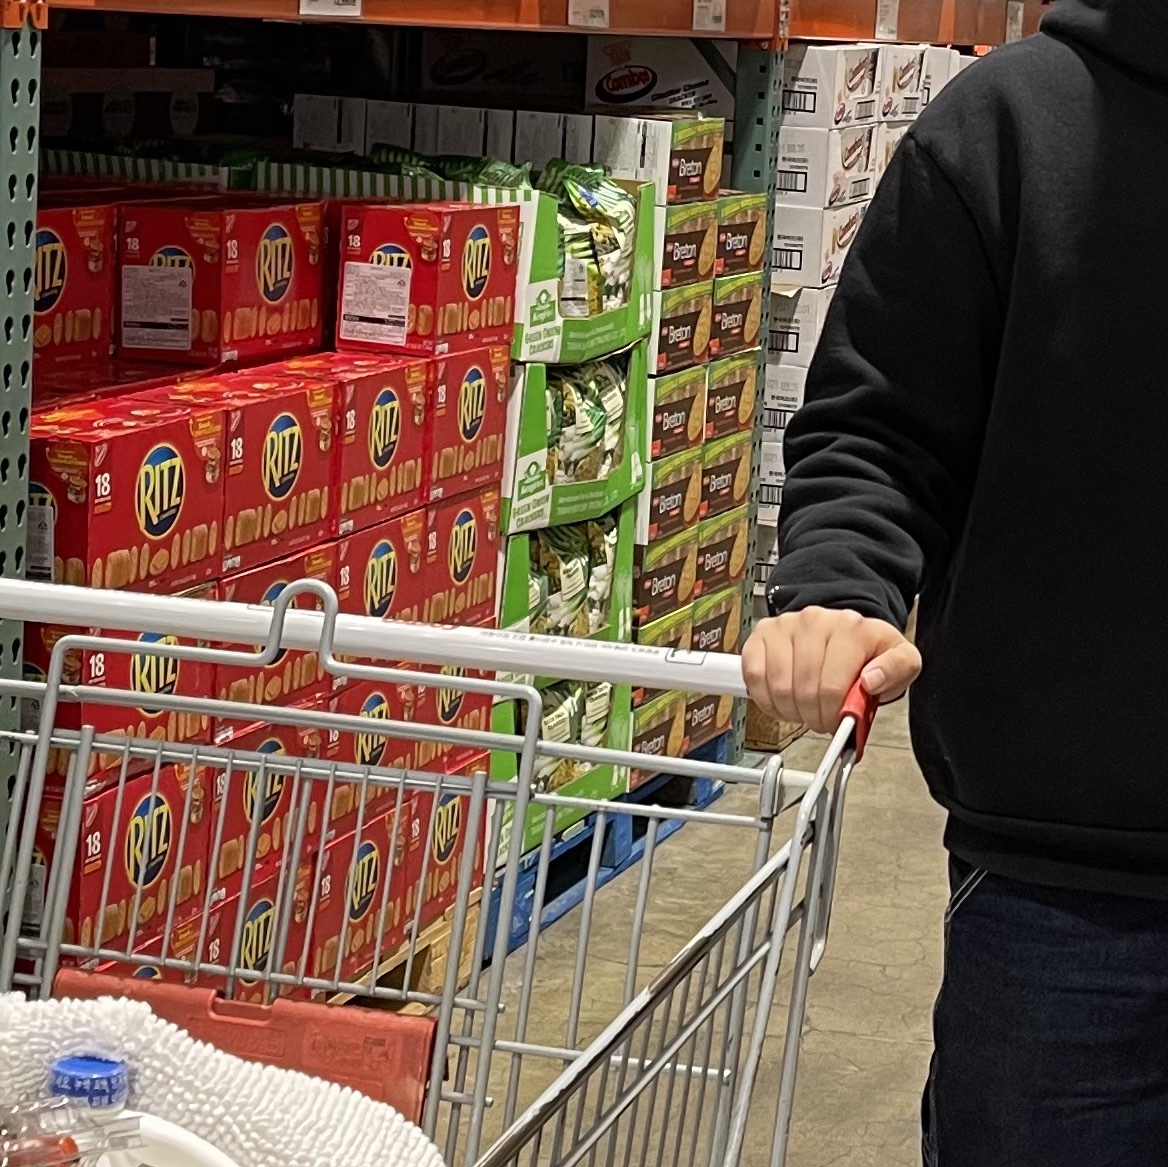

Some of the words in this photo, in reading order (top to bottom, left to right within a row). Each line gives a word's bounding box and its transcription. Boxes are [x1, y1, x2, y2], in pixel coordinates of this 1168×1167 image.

[679, 158, 703, 177] Breton
[126, 237, 140, 251] 18
[226, 239, 239, 259] 18
[348, 234, 361, 248] 18
[442, 239, 451, 258] 18
[674, 243, 697, 260] Breton
[726, 232, 748, 250] Breton
[260, 237, 293, 292] RITZ
[463, 237, 491, 289] RITZ
[721, 312, 743, 330] Breton
[668, 325, 691, 344] Breton
[437, 383, 446, 403] 18
[459, 378, 485, 428] RITZ
[715, 395, 737, 413] Breton
[346, 409, 356, 430] 18
[370, 401, 399, 457] RITZ
[662, 411, 686, 431] Breton
[231, 437, 243, 460] 18
[264, 425, 301, 494] RITZ
[95, 472, 111, 497] 18
[710, 473, 732, 492] Breton
[139, 457, 182, 531] RITZ
[659, 492, 682, 513] Breton
[427, 531, 437, 550] 18
[450, 518, 476, 572] RITZ
[704, 551, 728, 571] Breton
[340, 565, 350, 586] 18
[365, 550, 396, 612] RITZ
[651, 573, 676, 597] Breton
[699, 626, 722, 647] Breton
[89, 653, 105, 678] 18
[691, 703, 715, 726] Breton
[411, 818, 421, 838] 18
[435, 795, 460, 853] RITZ
[85, 831, 101, 857] 18
[128, 804, 169, 882] RTZ
[321, 875, 332, 895] 18
[209, 938, 220, 960] 18
